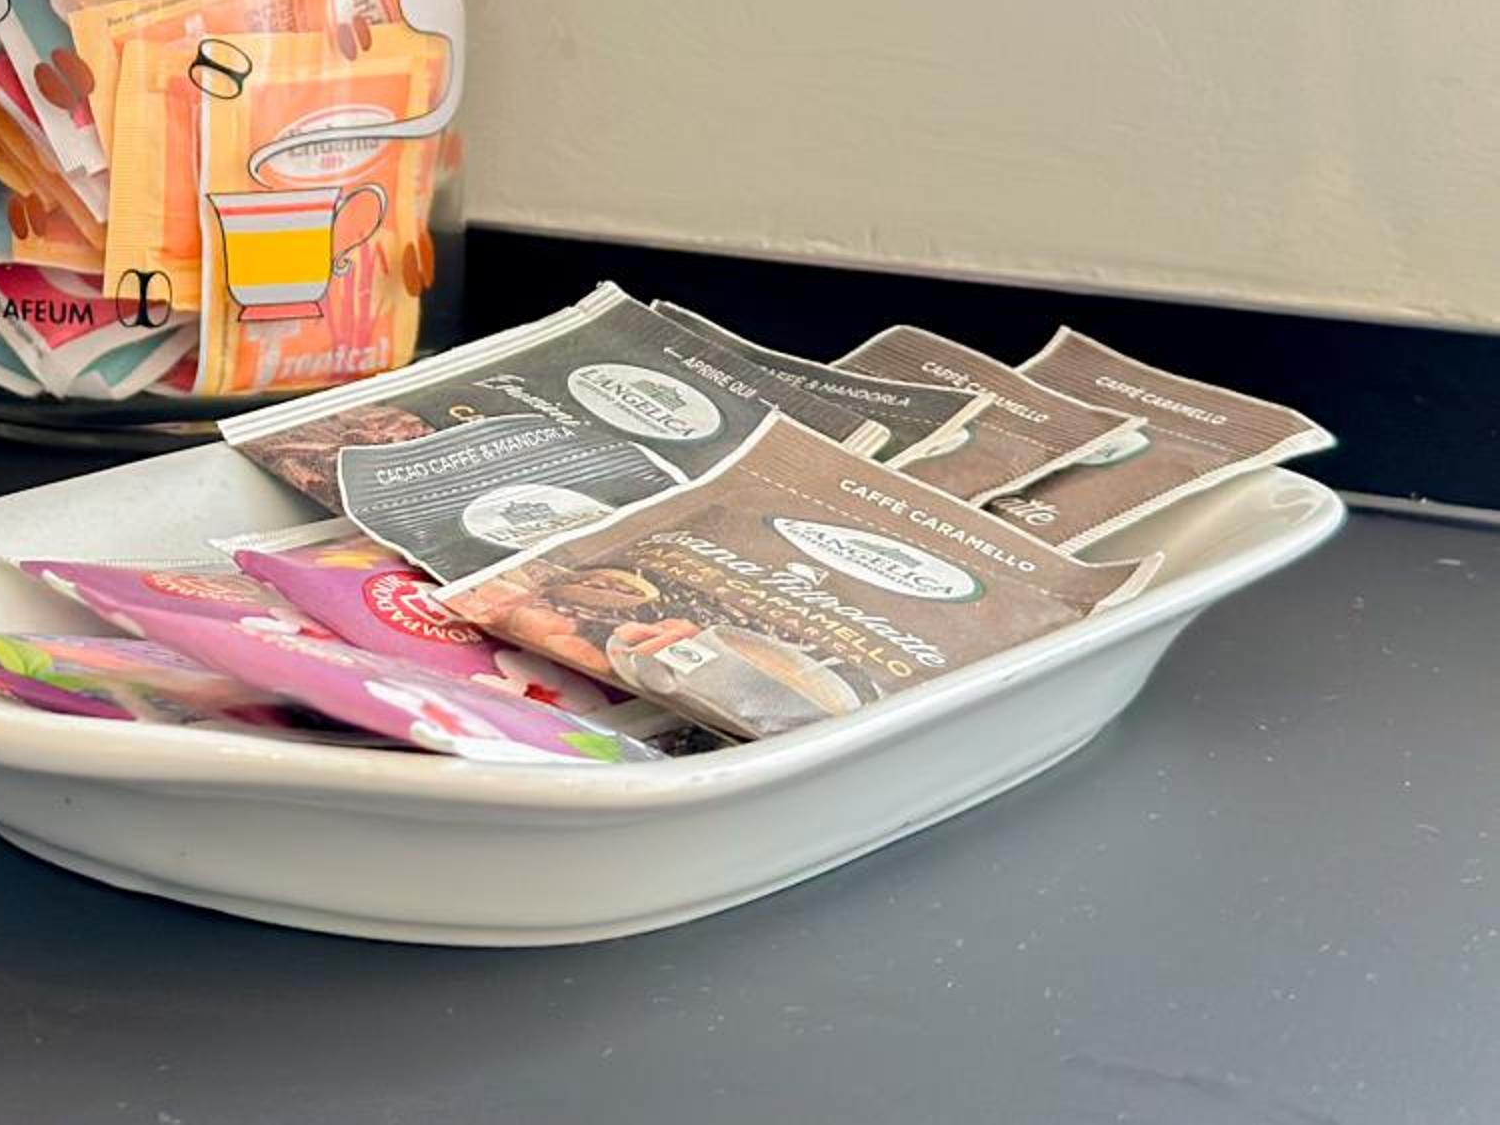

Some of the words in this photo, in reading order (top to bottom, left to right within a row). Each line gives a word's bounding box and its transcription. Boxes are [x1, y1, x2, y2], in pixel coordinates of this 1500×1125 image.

[681, 356, 732, 389] APRIRE
[730, 381, 758, 399] QUI
[1141, 393, 1228, 425] CARAMELLO
[375, 463, 429, 487] CACAO
[840, 478, 907, 515] CAFFÈ
[908, 508, 1037, 573] CARAMELLO
[726, 577, 914, 679] CARAMELLO
